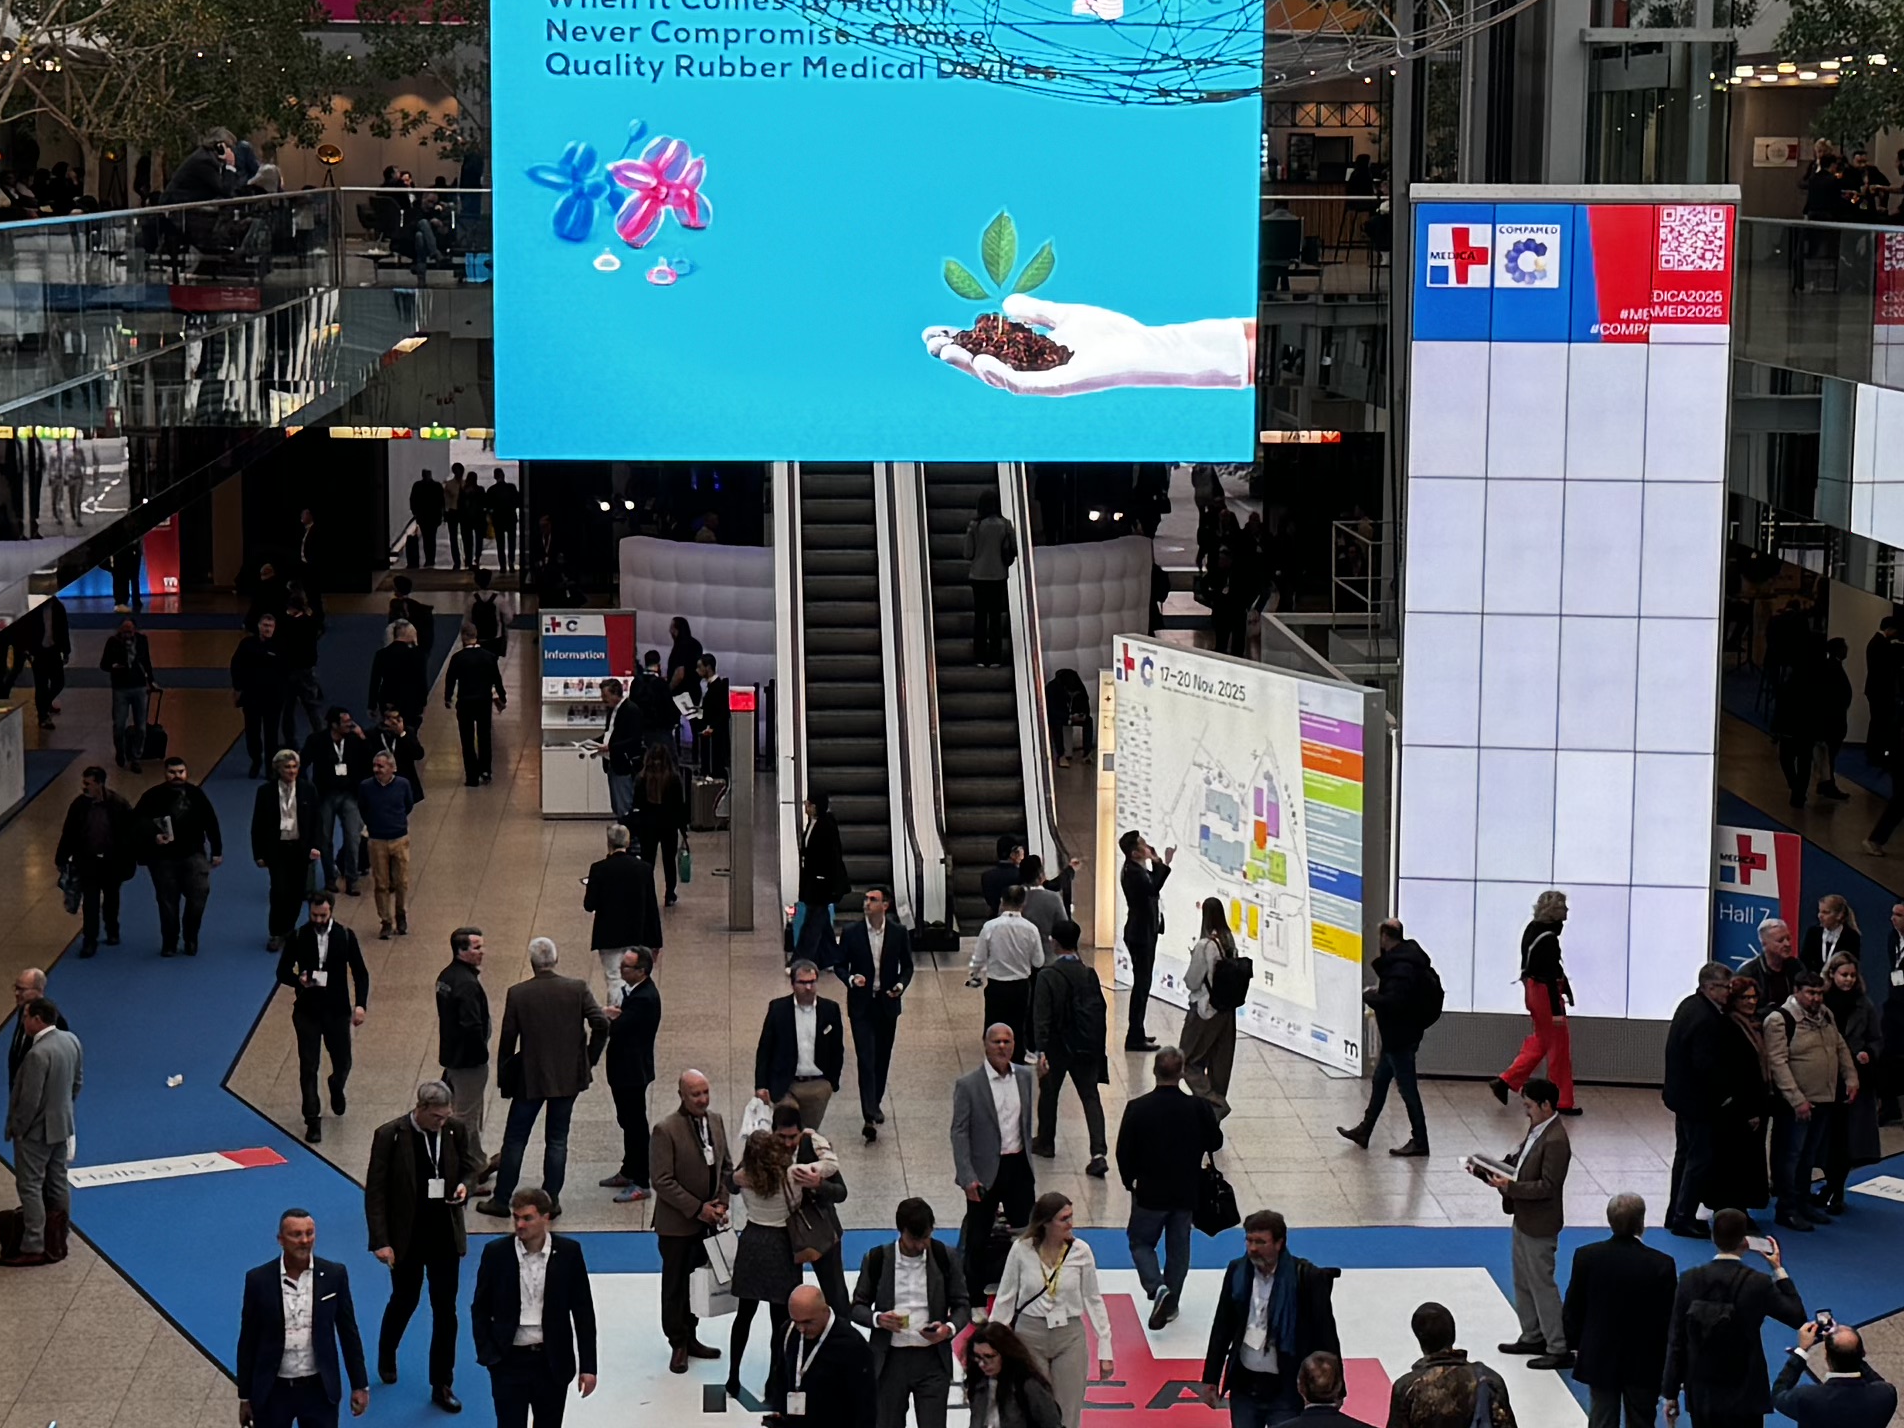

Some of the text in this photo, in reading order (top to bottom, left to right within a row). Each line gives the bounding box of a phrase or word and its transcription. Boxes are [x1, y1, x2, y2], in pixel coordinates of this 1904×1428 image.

[546, 18, 642, 43] Never
[545, 52, 665, 84] Quality
[675, 53, 792, 78] Rubber
[803, 55, 924, 80] Medical
[1498, 224, 1559, 236] COMPAMED
[1430, 250, 1477, 262] MEDICA
[544, 649, 605, 660] Information
[1218, 680, 1246, 702] 2025
[1719, 902, 1754, 925] Hall
